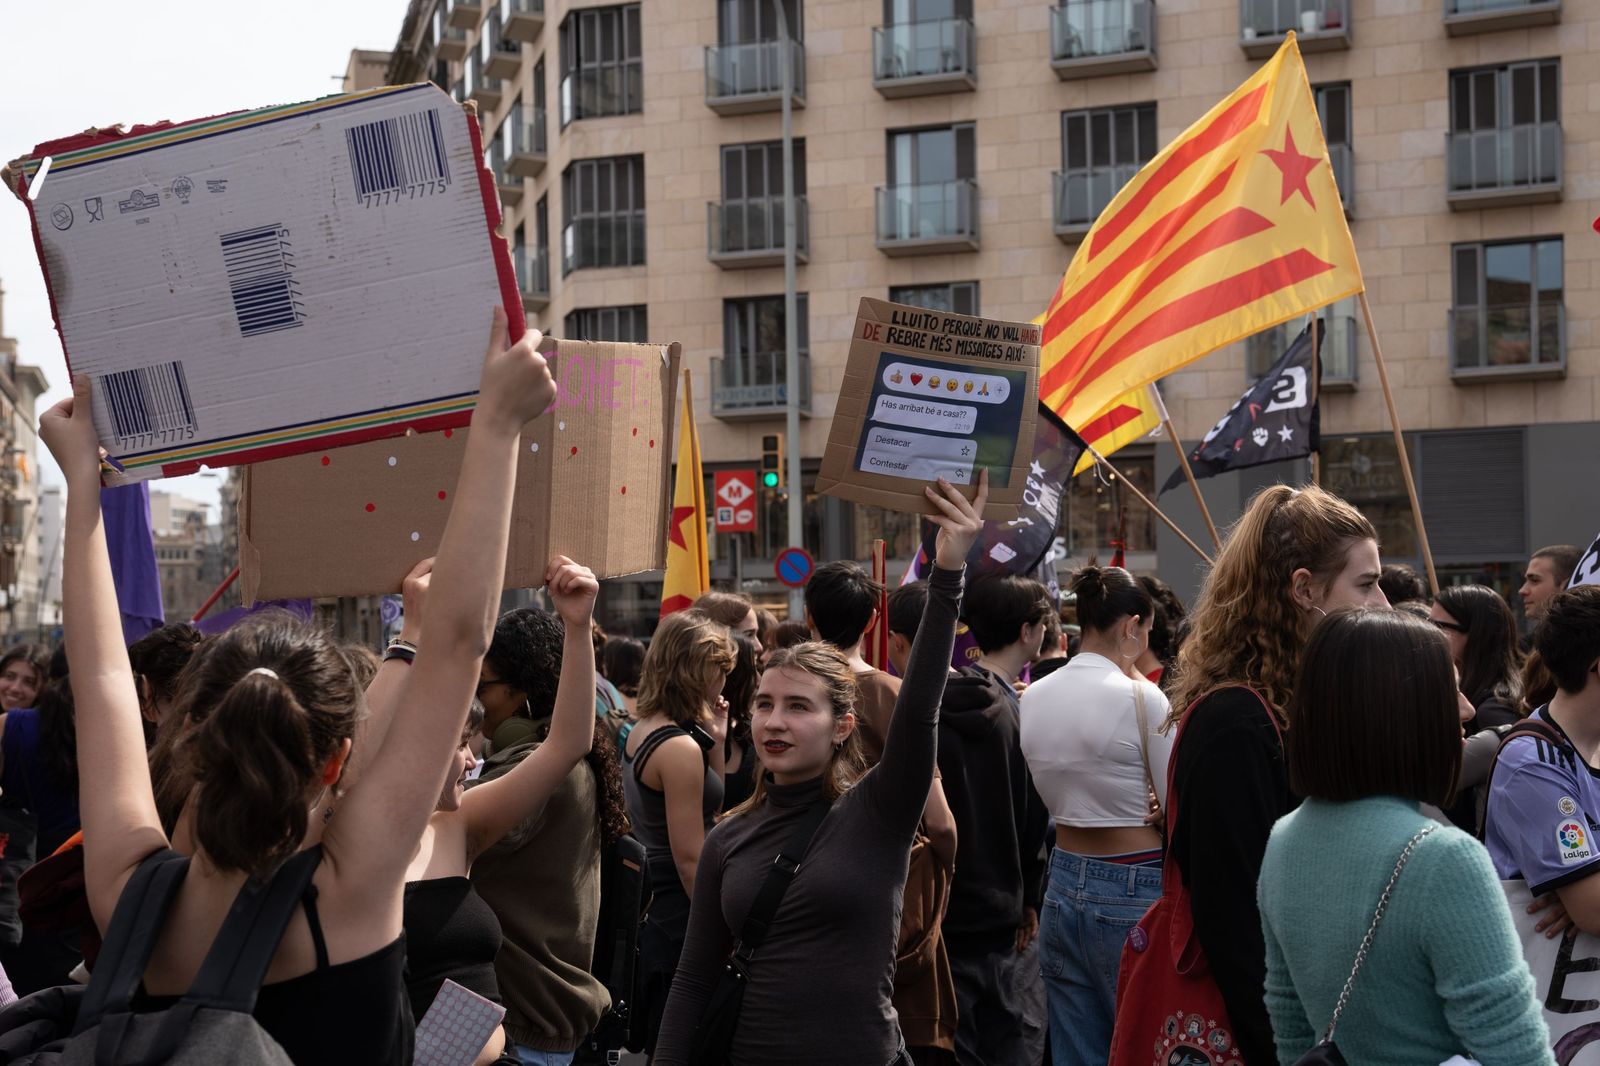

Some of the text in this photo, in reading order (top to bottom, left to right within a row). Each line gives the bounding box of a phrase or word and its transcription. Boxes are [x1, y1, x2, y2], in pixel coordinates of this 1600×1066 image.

[363, 179, 447, 209] 7777 7775
[277, 229, 308, 320] 7777 7775
[892, 310, 939, 331] LLUITO
[984, 324, 1000, 340] NO
[1003, 326, 1019, 341] VULL
[863, 322, 882, 341] DE
[886, 327, 928, 348] REBRE
[930, 333, 952, 352] MÉS
[955, 339, 1003, 359] MISSATGES
[881, 400, 897, 411] Has
[898, 403, 924, 414] arribat
[925, 406, 934, 416] bé
[943, 410, 968, 419] casa??
[121, 426, 195, 451] 7777 7775
[875, 435, 911, 448] Destacar
[869, 457, 909, 470] Contestar
[728, 486, 742, 498] M
[1563, 849, 1590, 860] LaLiga
